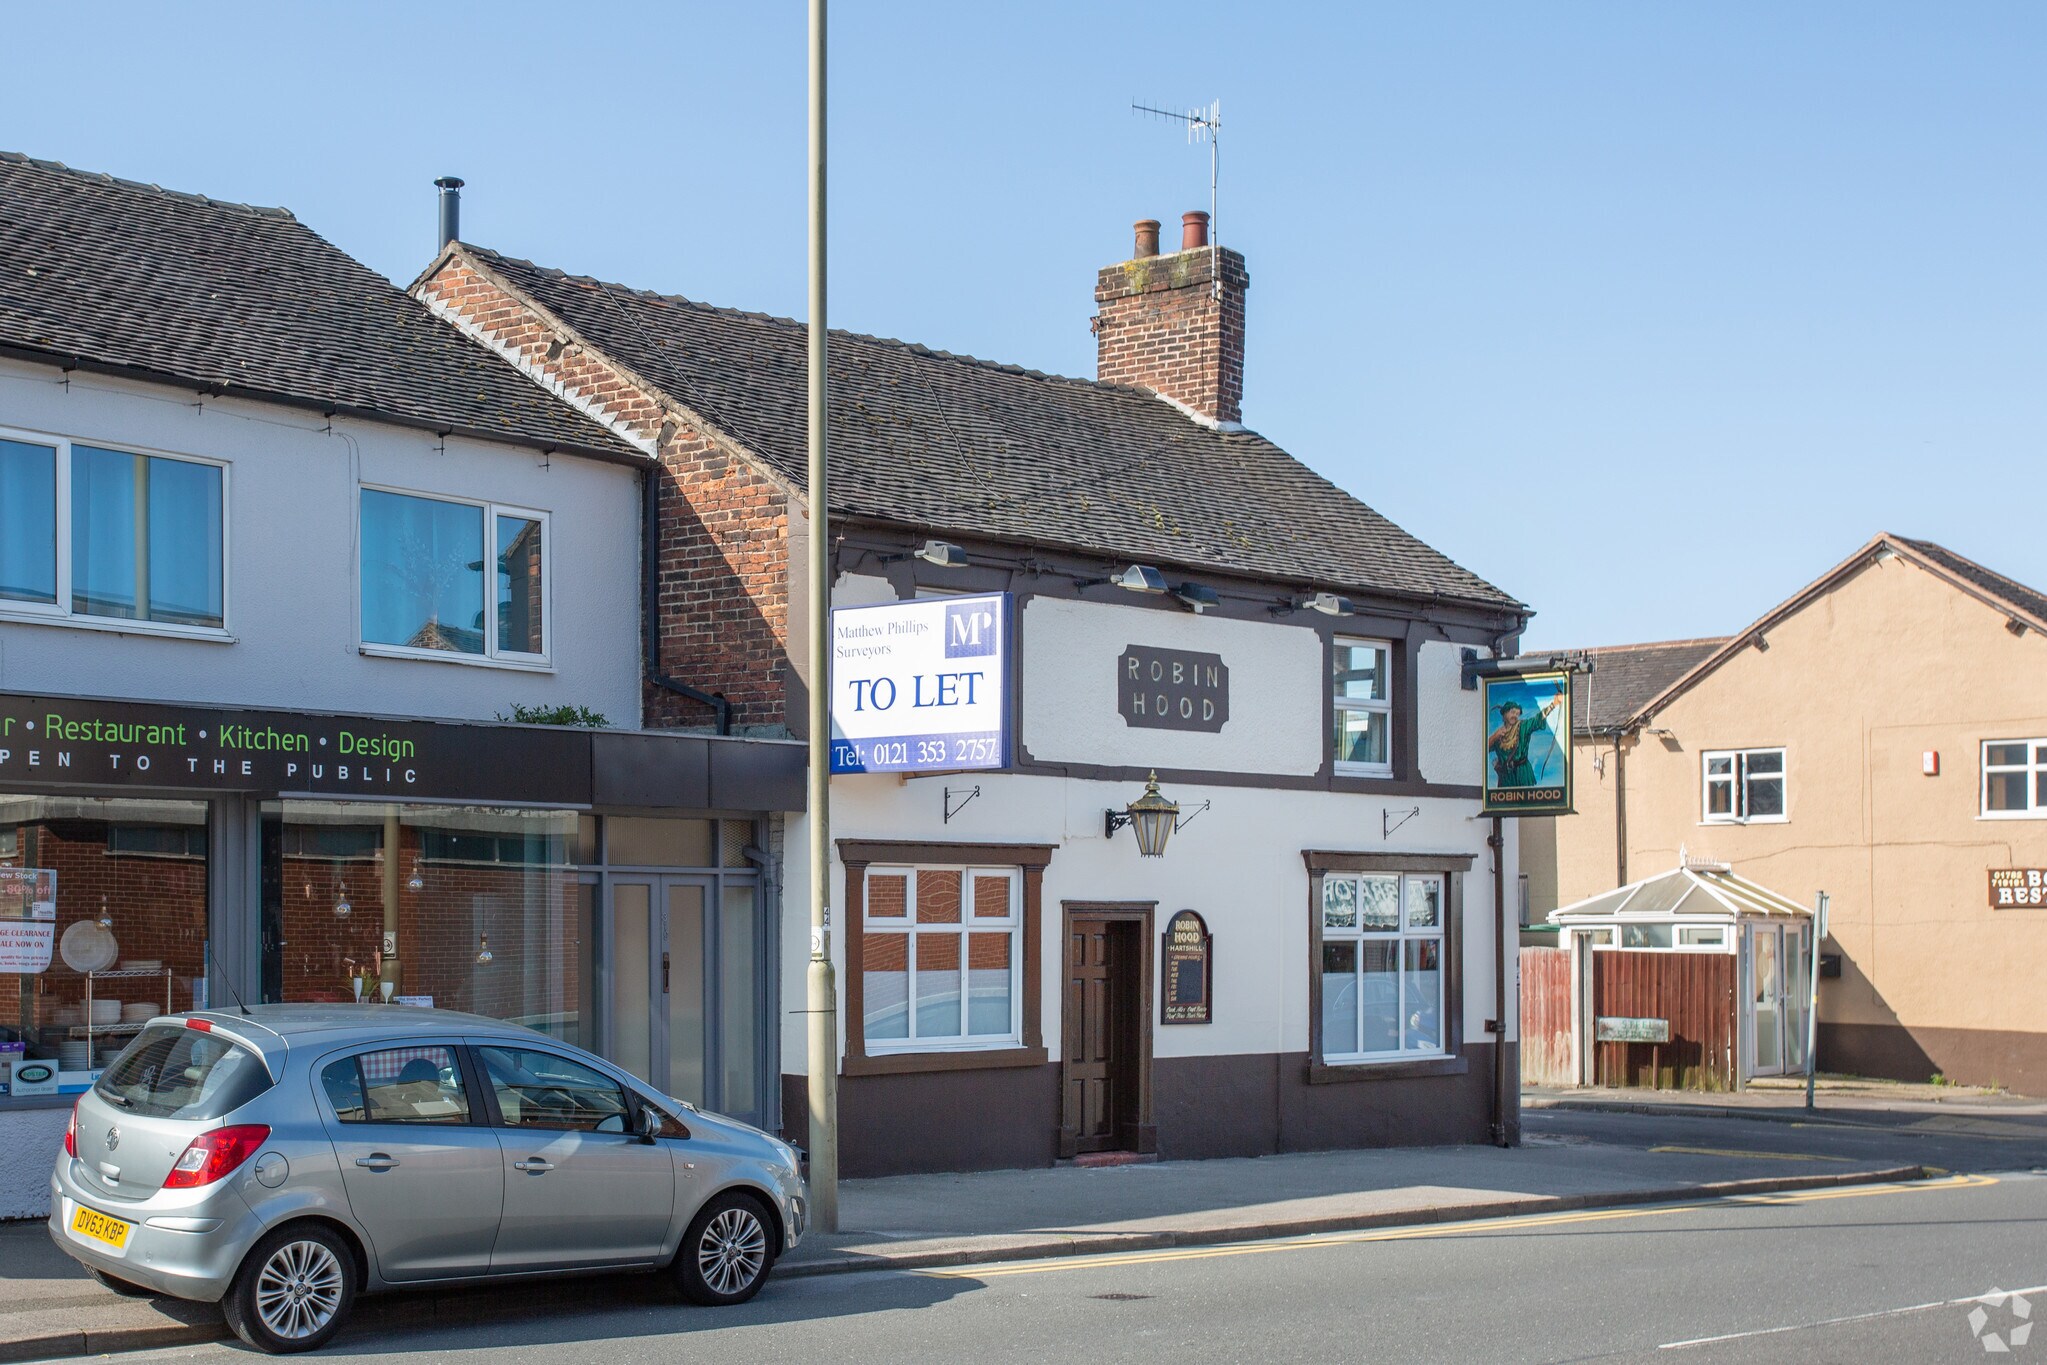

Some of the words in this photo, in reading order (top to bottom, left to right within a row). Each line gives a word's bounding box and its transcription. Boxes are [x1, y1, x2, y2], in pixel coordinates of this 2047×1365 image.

[837, 624, 883, 640] Matthew
[888, 620, 929, 636] Phillips
[837, 644, 891, 659] Surveyors
[1128, 657, 1218, 688] ROBIN
[849, 677, 896, 712] TO
[912, 671, 984, 708] LET
[1133, 692, 1215, 721] HOOD
[0, 717, 16, 737] r
[46, 714, 187, 746] Restaurant
[220, 725, 309, 752] Kitchen
[339, 731, 415, 763] Design
[835, 744, 865, 767] Tel:
[873, 742, 908, 765] 0121
[917, 740, 946, 763] 353
[955, 738, 996, 761] 2757
[110, 754, 150, 771] TO
[188, 758, 252, 776] THE
[287, 763, 416, 784] PUBLIC
[1490, 791, 1525, 802] ROBIN
[1528, 789, 1561, 800] HOOD
[15, 872, 38, 880] Stock
[1994, 870, 2022, 880] 01782
[2027, 870, 2047, 887] B
[11, 930, 52, 938] CLEARANCE
[1175, 920, 1199, 932] ROBIN
[1174, 932, 1200, 943] HOOD
[77, 1210, 105, 1235] DV63
[103, 1220, 125, 1242] KBP
